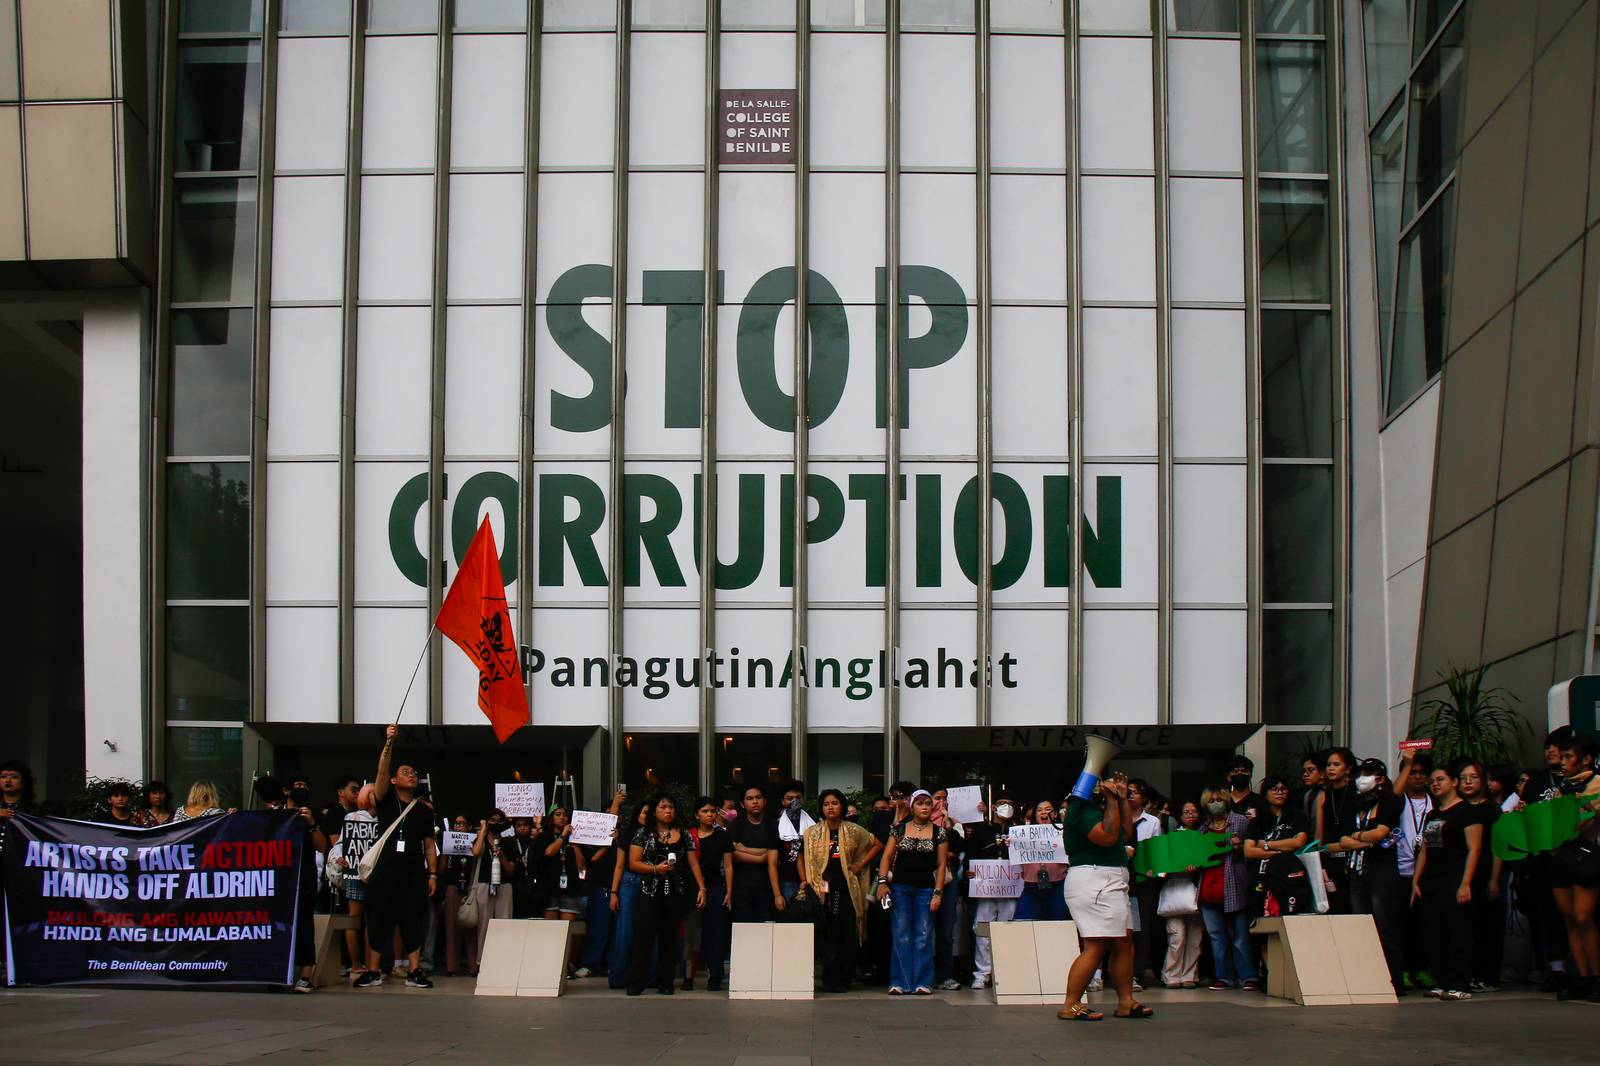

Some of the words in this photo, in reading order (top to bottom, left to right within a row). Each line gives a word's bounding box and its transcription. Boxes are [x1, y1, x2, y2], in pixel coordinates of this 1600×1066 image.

[726, 100, 739, 108] DE
[741, 100, 754, 108] LA
[726, 112, 791, 123] COLLEGE
[726, 127, 746, 138] OF
[749, 127, 791, 138] SAINT
[725, 142, 791, 153] BENILDE
[545, 263, 969, 433] STOP
[388, 471, 1122, 591] CORRUPTION
[24, 840, 129, 871] ARTISTS
[137, 843, 195, 871] TAKE
[200, 840, 292, 869] ACTION!
[42, 870, 129, 900] HANDS
[137, 873, 180, 900] OFF
[185, 870, 275, 899] ALDRIN!
[975, 884, 1017, 896] KURAKOT
[47, 910, 135, 928] IKULONG
[141, 912, 179, 928] ANG
[185, 910, 269, 926] KAWATAN
[43, 925, 103, 942] HINDI
[107, 927, 147, 942] ANG
[152, 925, 273, 943] LUMALABAN!
[87, 959, 107, 971] The
[109, 959, 166, 972] Benildean
[168, 960, 228, 973] Community
